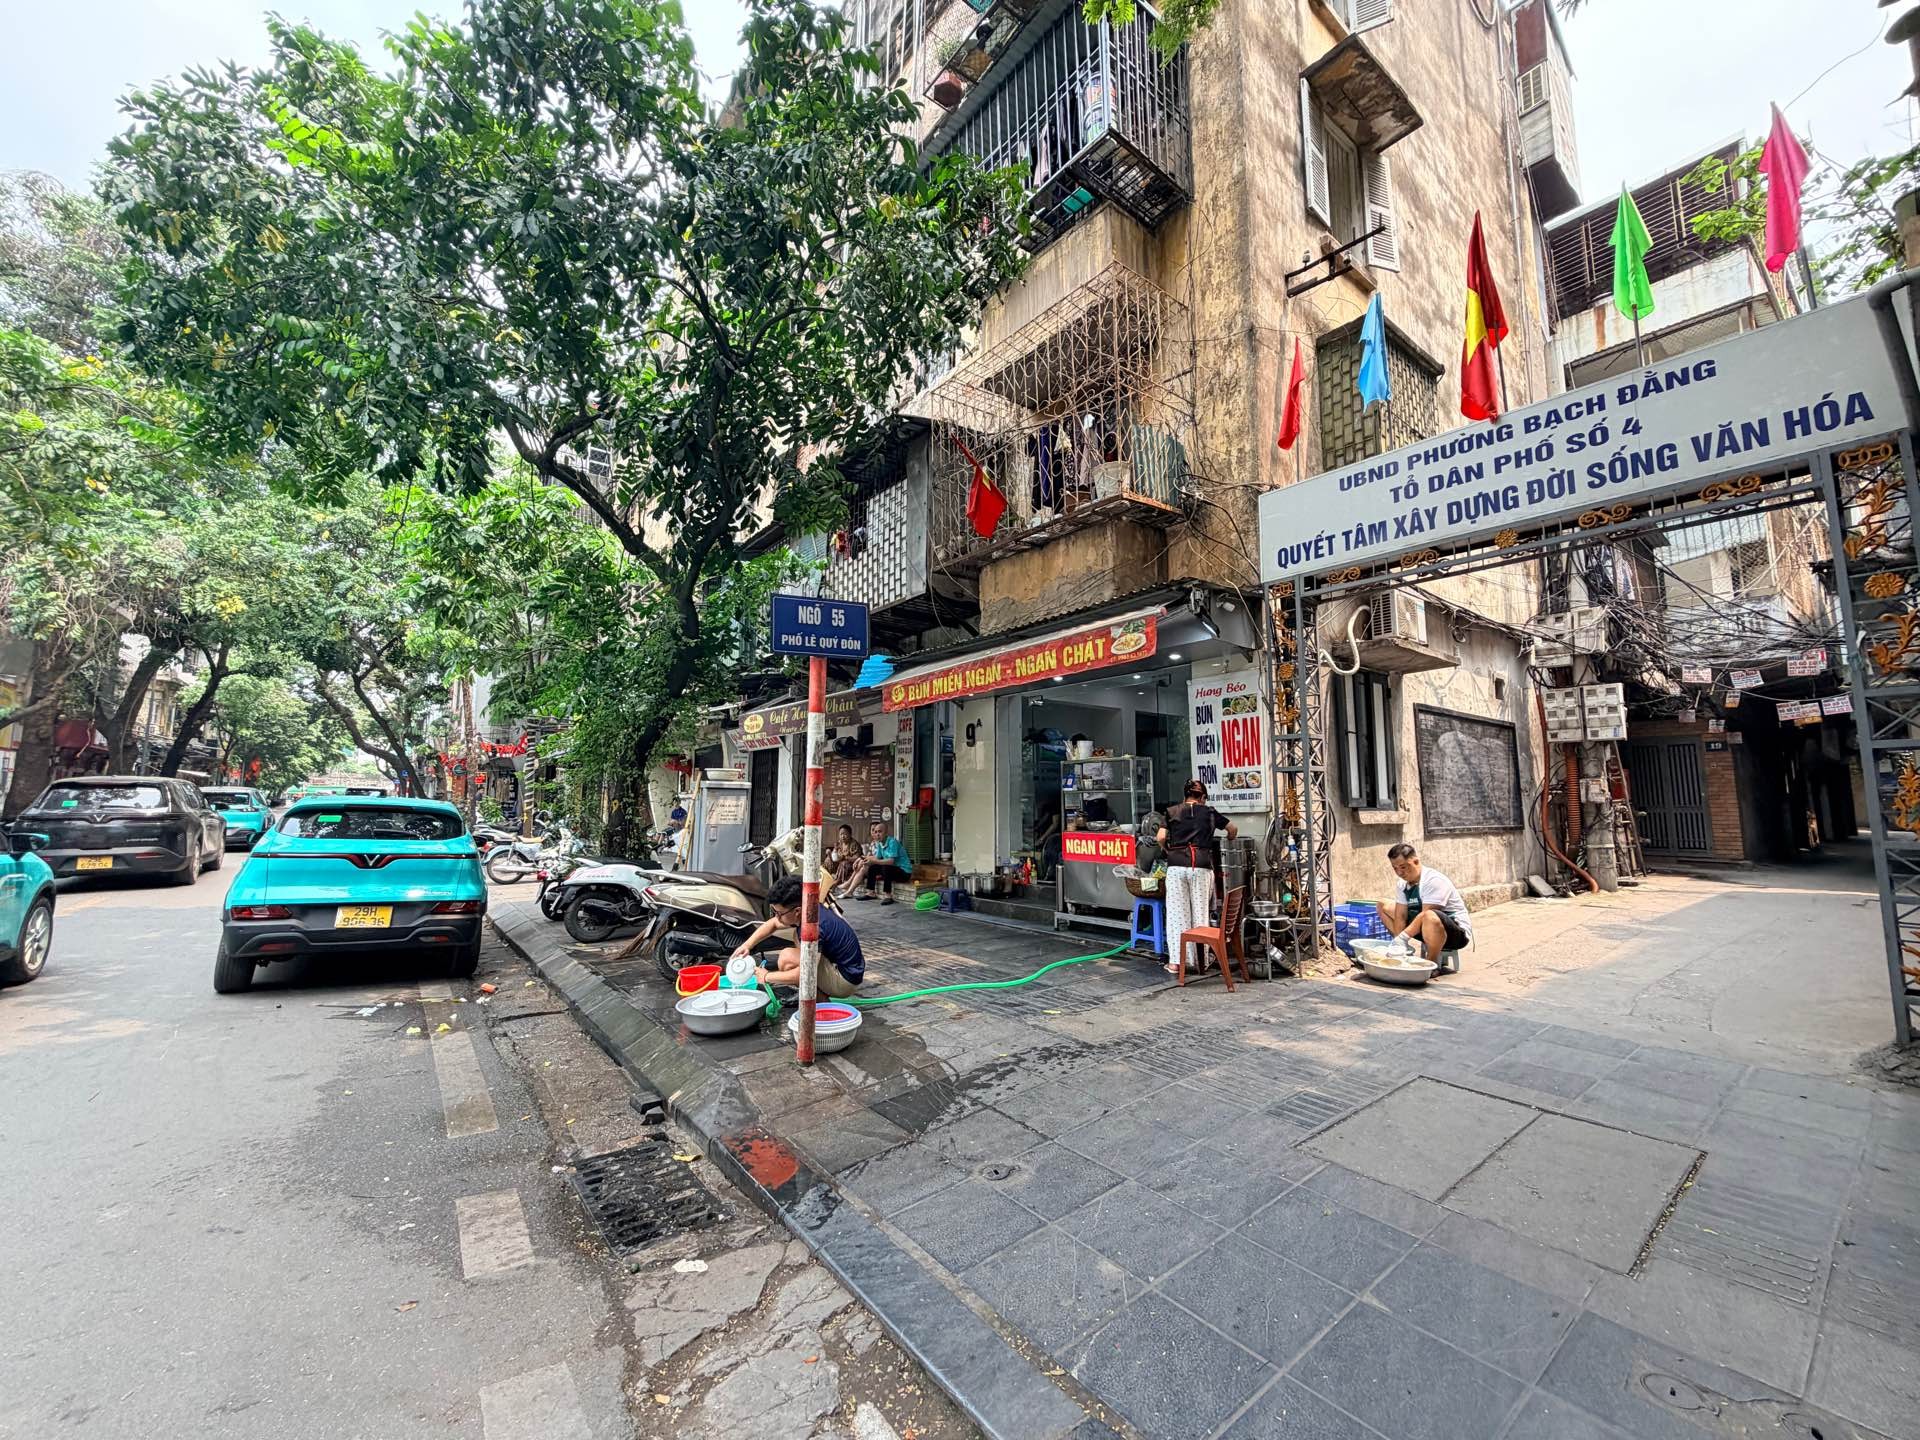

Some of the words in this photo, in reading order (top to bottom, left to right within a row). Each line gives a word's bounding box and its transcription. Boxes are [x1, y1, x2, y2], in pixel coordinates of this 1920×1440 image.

[1339, 460, 1400, 492] UBND
[1407, 423, 1514, 471] PHƯỜNG
[1523, 393, 1607, 435] BẠCH
[1616, 359, 1717, 406] ĐẰNG
[1389, 474, 1419, 503] TỔ
[1428, 461, 1484, 494] DÂN
[1494, 433, 1555, 475] PHỐ
[1566, 416, 1610, 454] SỐ
[1621, 416, 1643, 436] 4
[1277, 530, 1336, 569] QUYẾT
[1341, 520, 1388, 551] TÂM
[1393, 506, 1438, 539] XÂY
[1447, 484, 1520, 526] DỰNG
[1526, 467, 1576, 505] ĐỜI
[1586, 445, 1679, 490] SỐNG
[1690, 417, 1771, 463] VĂN
[1782, 391, 1875, 441] HÓA
[798, 603, 824, 626] NGÕ
[831, 608, 845, 627] 55
[781, 632, 804, 646] PHỐ
[805, 634, 817, 647] LÊ
[819, 635, 839, 649] QUÝ
[840, 637, 861, 651] ĐÔN
[908, 682, 930, 702] BÚN
[932, 669, 963, 696] MIẾN
[965, 663, 1002, 689] NGAN
[1015, 649, 1058, 678] NGAN
[1062, 635, 1106, 668] CHẶT
[1226, 681, 1247, 694] Béo
[1195, 701, 1214, 726] BÚN
[1195, 728, 1216, 755] MIẾN
[1221, 716, 1262, 769] NGAN
[1197, 760, 1218, 789] TRỘN
[1065, 838, 1096, 855] NGAN
[1099, 838, 1129, 861] CHẶT
[354, 906, 378, 917] 29H
